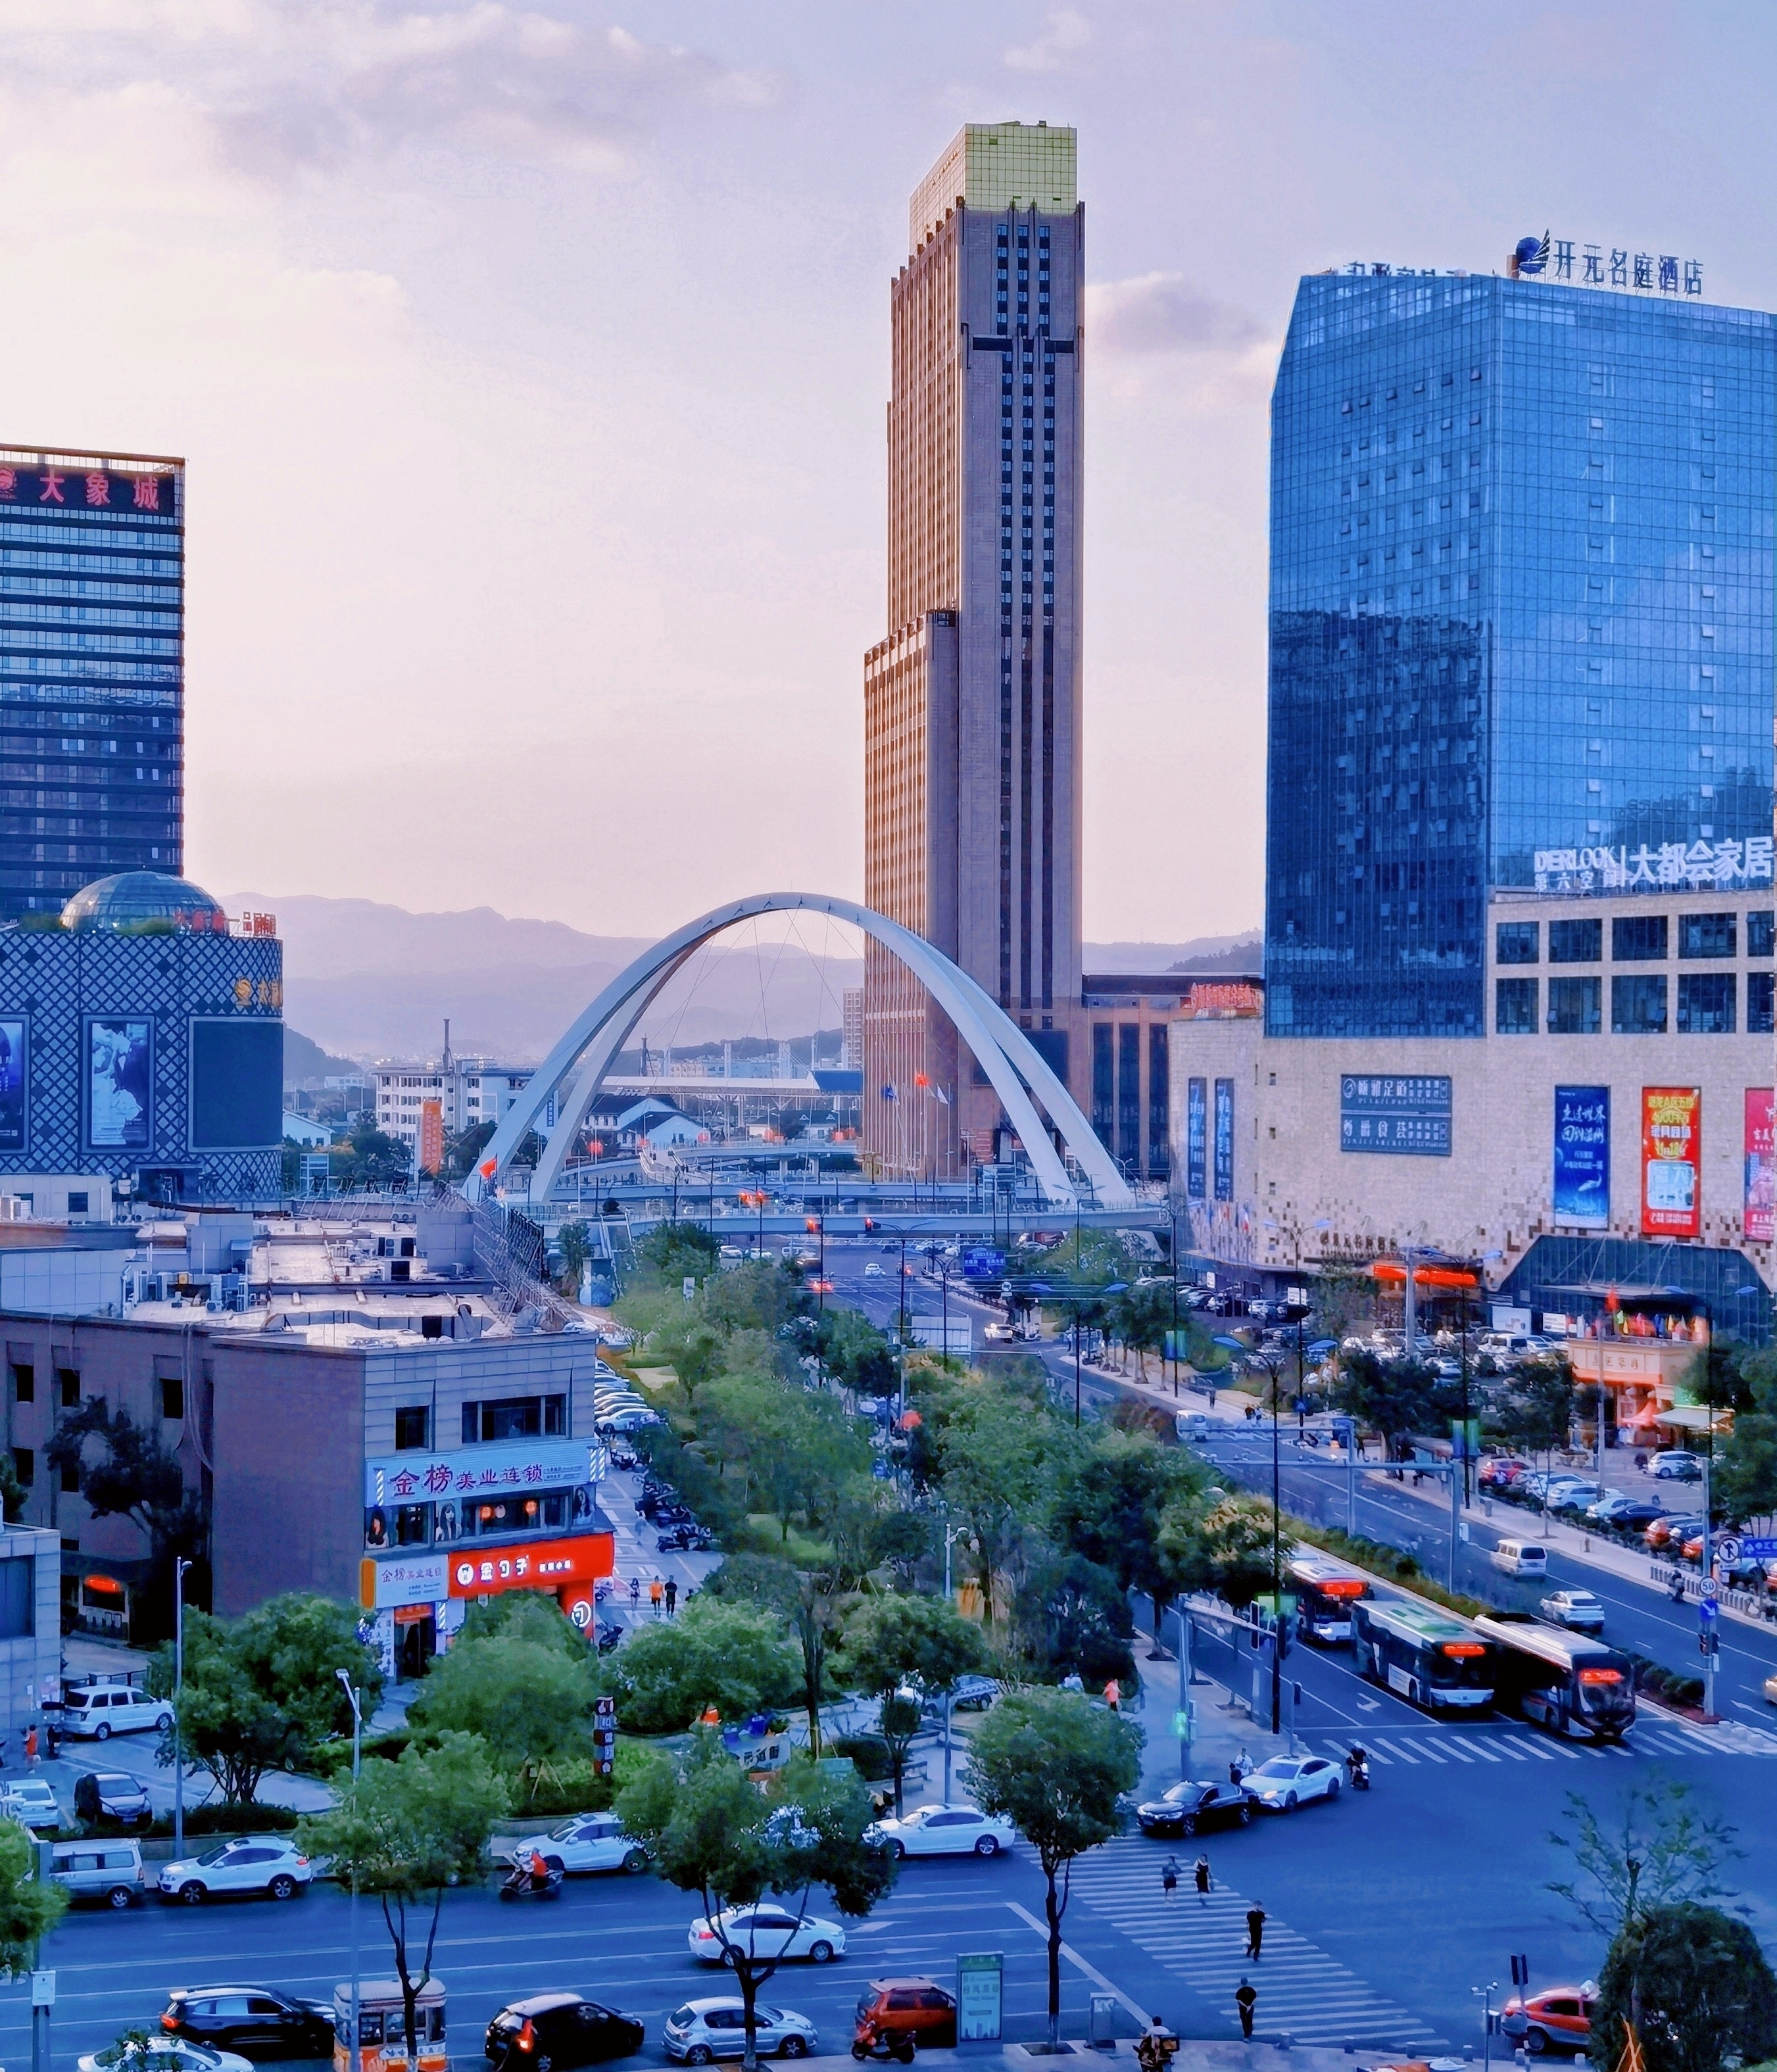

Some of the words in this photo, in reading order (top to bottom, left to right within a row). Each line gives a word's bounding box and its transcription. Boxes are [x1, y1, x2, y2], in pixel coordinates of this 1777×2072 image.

[1553, 240, 1704, 295] 开元名庭酒店
[39, 468, 160, 510] 大象城
[1534, 846, 1617, 873] DERLOOK
[1629, 836, 1773, 885] 大都会家居
[389, 1463, 543, 1497] 金榜美业连锁
[1703, 1581, 1715, 1590] 50
